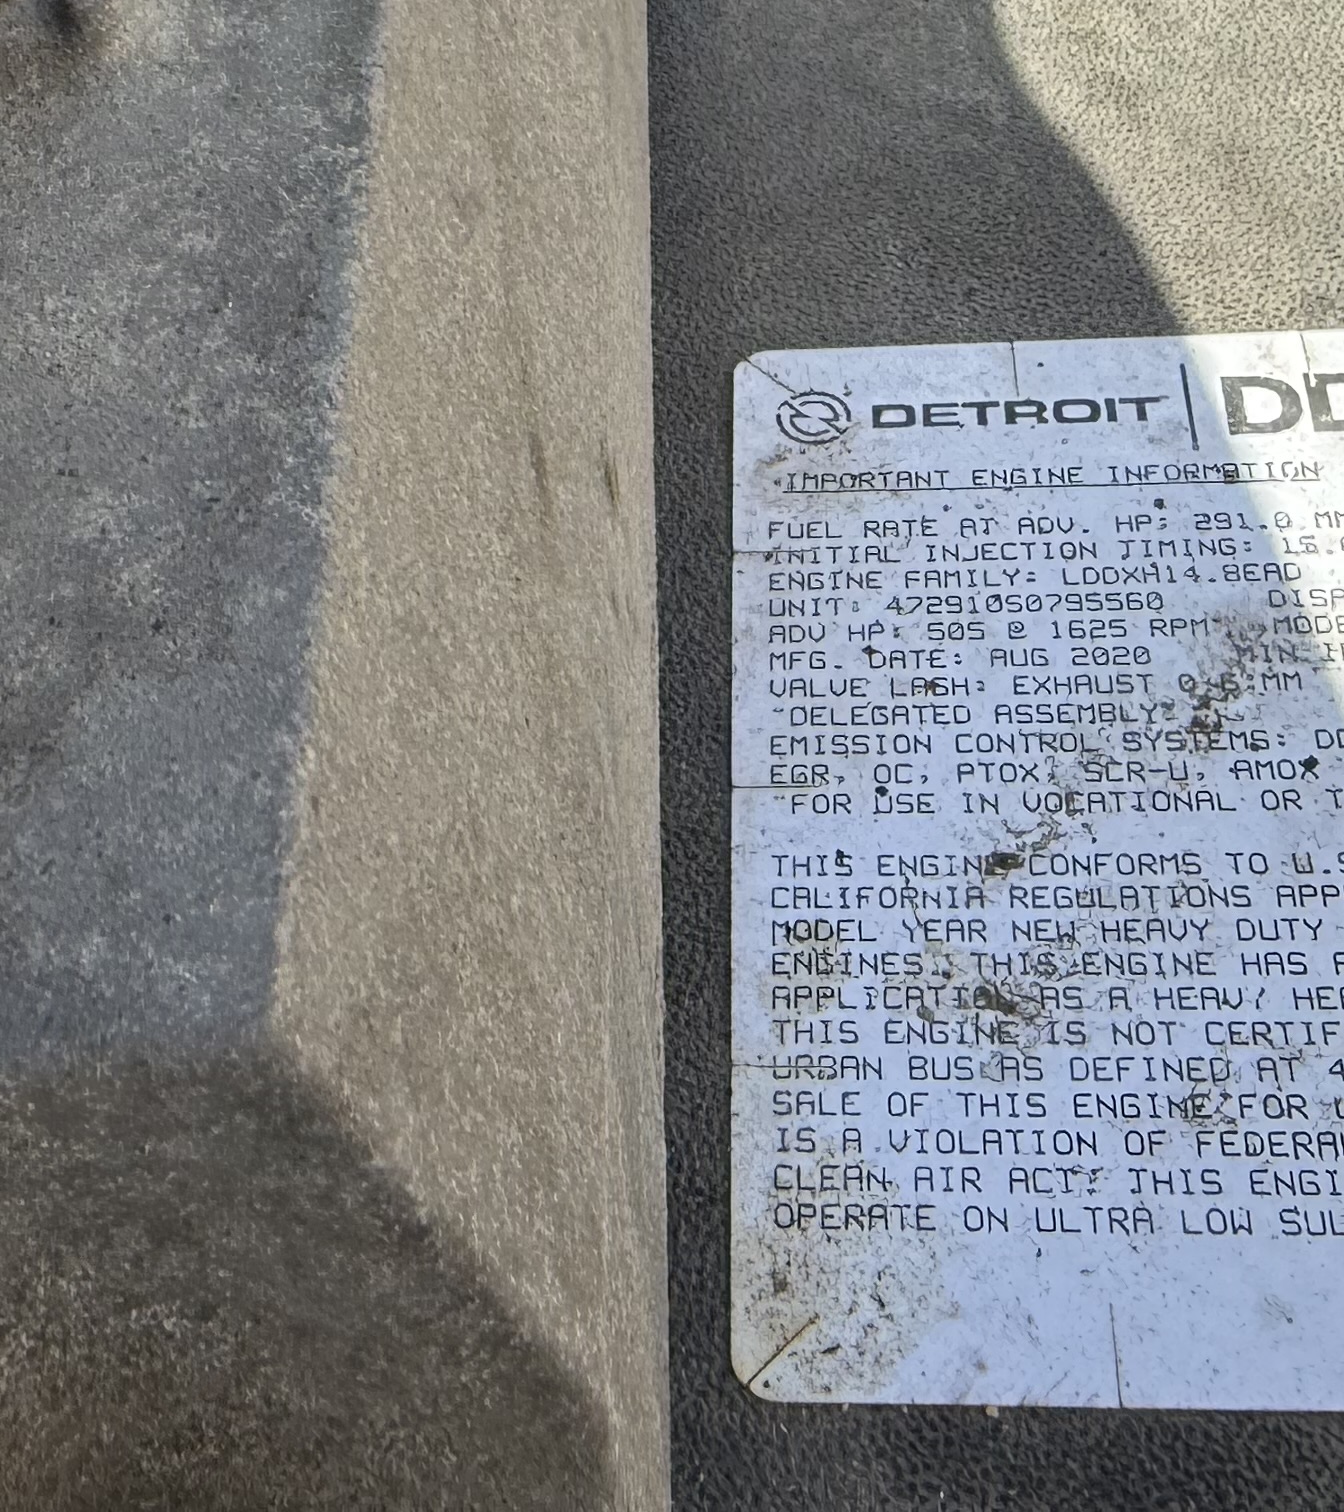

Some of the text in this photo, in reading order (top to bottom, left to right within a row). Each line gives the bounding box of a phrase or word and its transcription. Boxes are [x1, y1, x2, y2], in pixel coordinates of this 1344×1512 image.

[871, 396, 1168, 429] DETROIT
[786, 462, 1320, 491] IMPORTANT ENGINE INFORMATION
[768, 520, 842, 540] FUEL
[863, 518, 939, 539] RATE
[960, 518, 998, 539] AT
[1018, 516, 1091, 536] ADV.
[1116, 514, 1168, 535] HP:
[1194, 511, 1292, 532] 291.0
[773, 545, 901, 565] INITIAL
[926, 541, 1098, 562] INJECTION
[1120, 538, 1253, 561] TIMING:
[768, 571, 883, 591] ENGINE
[905, 567, 1037, 589] FAMILY:
[768, 597, 860, 618] UNIT:
[885, 591, 1164, 615] 47291050795560
[768, 624, 826, 644] ADV
[848, 622, 901, 642] HP:
[927, 621, 986, 641] 505
[1007, 621, 1027, 639] @
[1051, 619, 1128, 639] 1625
[1149, 617, 1211, 638] RPM
[769, 650, 843, 671] MFG.
[867, 648, 963, 670] DATE:
[990, 647, 1049, 668] AUG
[1071, 645, 1151, 666] 2020
[1236, 642, 1298, 664] MIN
[769, 678, 869, 699] VALVE
[1013, 673, 1154, 695] EXHAUST
[1262, 671, 1303, 692] MM
[770, 734, 933, 756] EMISSION
[956, 731, 1100, 754] CONTROL
[1122, 729, 1287, 753] SYSTEMS:
[770, 763, 846, 786] EGR,
[873, 763, 929, 785] OC,
[1085, 760, 1206, 783] SCR-U,
[1233, 758, 1320, 781] AMOX
[873, 792, 937, 815] USE
[964, 791, 1000, 815] IN
[1022, 790, 1237, 815] VOCATIONAL
[1260, 789, 1303, 812] OR
[771, 854, 853, 877] THIS
[1029, 852, 1202, 876] CONFORMS
[1225, 852, 1269, 875] TO
[771, 886, 987, 910] CALIFORNIA
[1009, 885, 1253, 910] REGULATIONS
[771, 918, 878, 944] MODEL
[902, 918, 988, 943] YEAR
[1011, 918, 1076, 942] NEW
[1101, 918, 1209, 943] HEAVY
[1236, 918, 1323, 942] DUTY
[970, 951, 1058, 977] THIS
[1082, 951, 1218, 977] ENGINE
[1241, 951, 1308, 977] HAS
[1039, 985, 1084, 1011] AS
[1109, 985, 1131, 1011] A
[773, 1019, 859, 1045] THIS
[884, 1019, 1019, 1046] ENGINE
[1046, 1019, 1087, 1045] IS
[1112, 1020, 1177, 1046] NOT
[771, 1054, 883, 1081] URBAN
[908, 1055, 974, 1081] BUS
[1000, 1055, 1044, 1082] AS
[1069, 1056, 1232, 1083] DEFINED
[1258, 1056, 1300, 1083] AT
[771, 1090, 862, 1117] SALE
[887, 1091, 929, 1117] OF
[955, 1092, 1047, 1118] THIS
[1073, 1092, 1213, 1119] ENGINE
[1238, 1093, 1309, 1120] FOR
[776, 1127, 816, 1153] IS
[842, 1128, 862, 1155] A
[889, 1128, 1098, 1156] VIOLATION
[1123, 1130, 1166, 1157] OF
[773, 1165, 890, 1193] CLEAN
[914, 1166, 982, 1193] AIR
[1128, 1168, 1224, 1196] THIS
[773, 1203, 937, 1232] OPERATE
[963, 1205, 1008, 1234] ON
[1035, 1206, 1155, 1235] ULTRA
[1181, 1208, 1253, 1236] LOW
